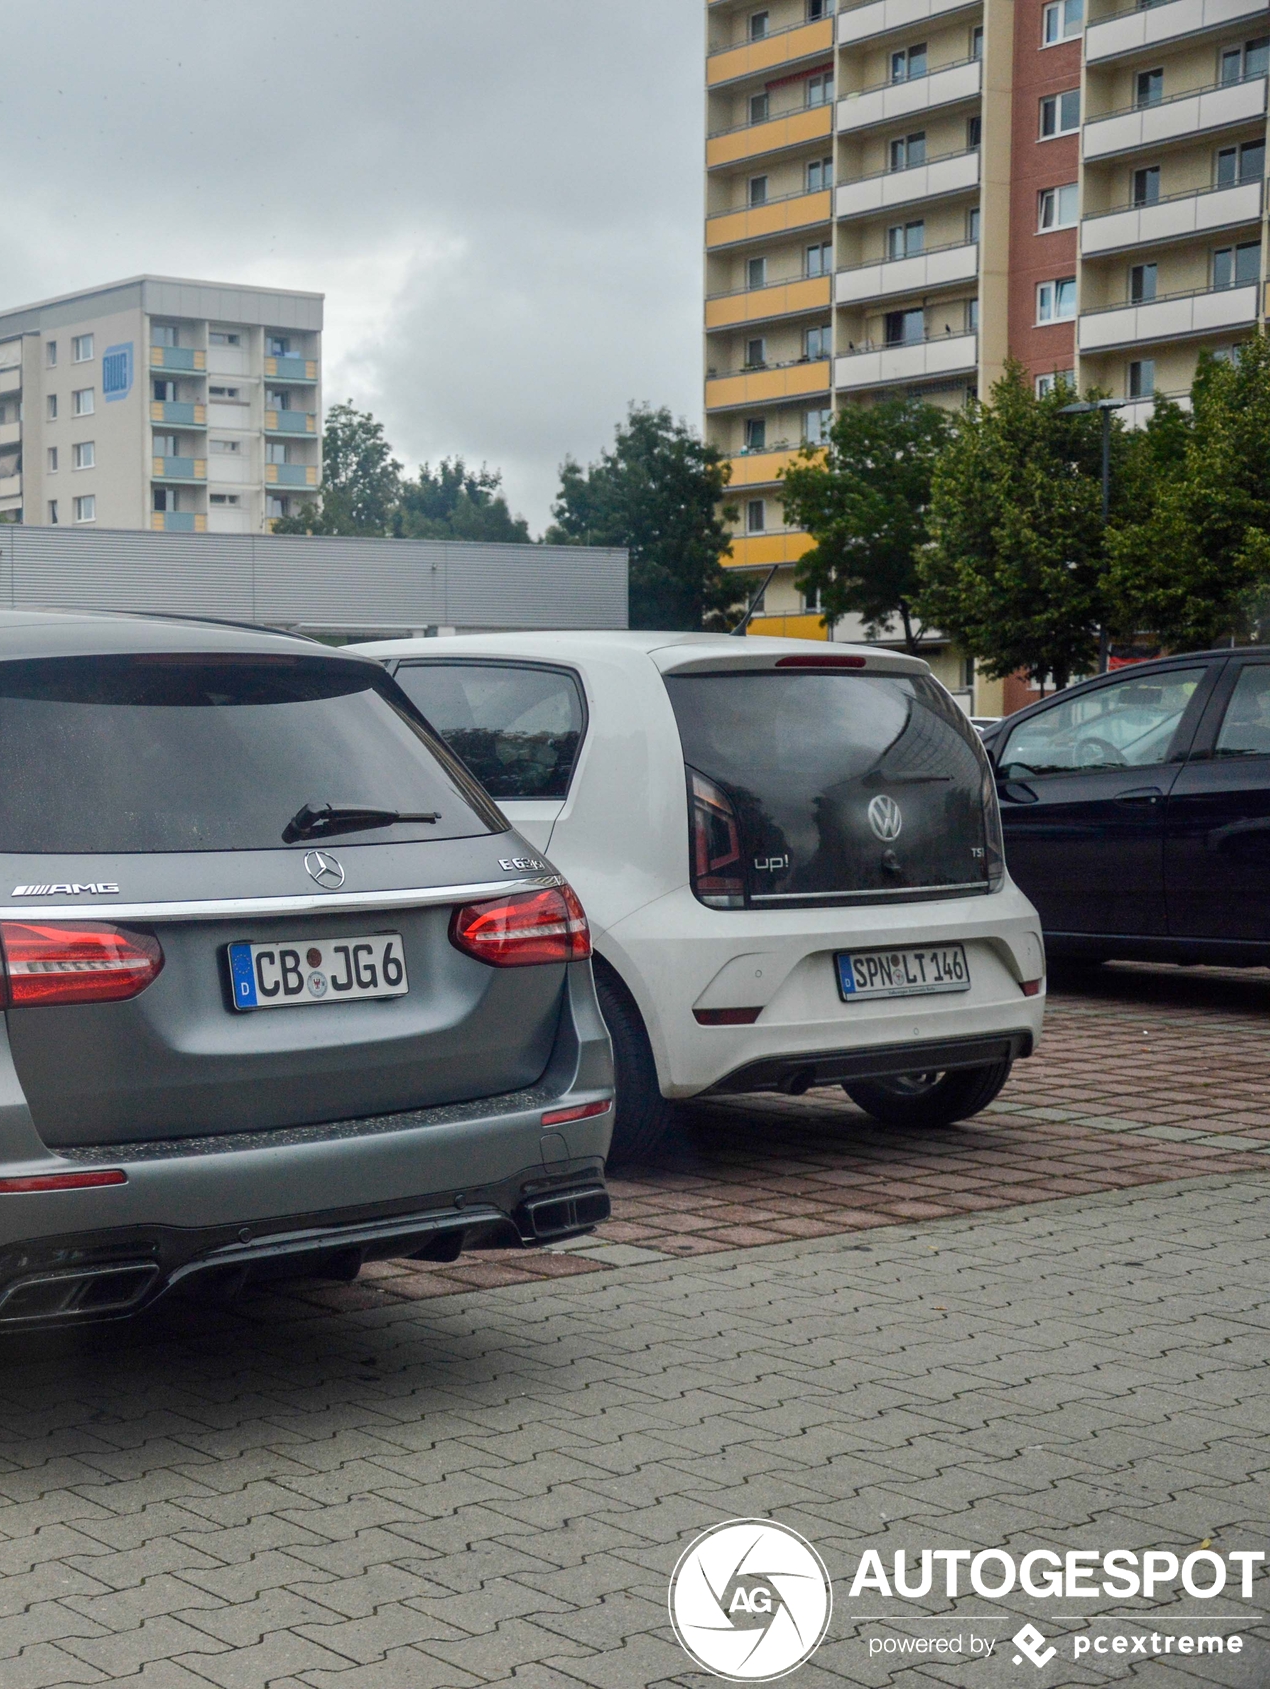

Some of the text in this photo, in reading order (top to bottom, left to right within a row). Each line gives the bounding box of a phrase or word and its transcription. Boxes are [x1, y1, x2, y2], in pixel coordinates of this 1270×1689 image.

[497, 859, 513, 871] E
[754, 854, 789, 872] up!
[240, 982, 250, 996] D
[256, 949, 304, 997] CB
[853, 956, 893, 988] SPN
